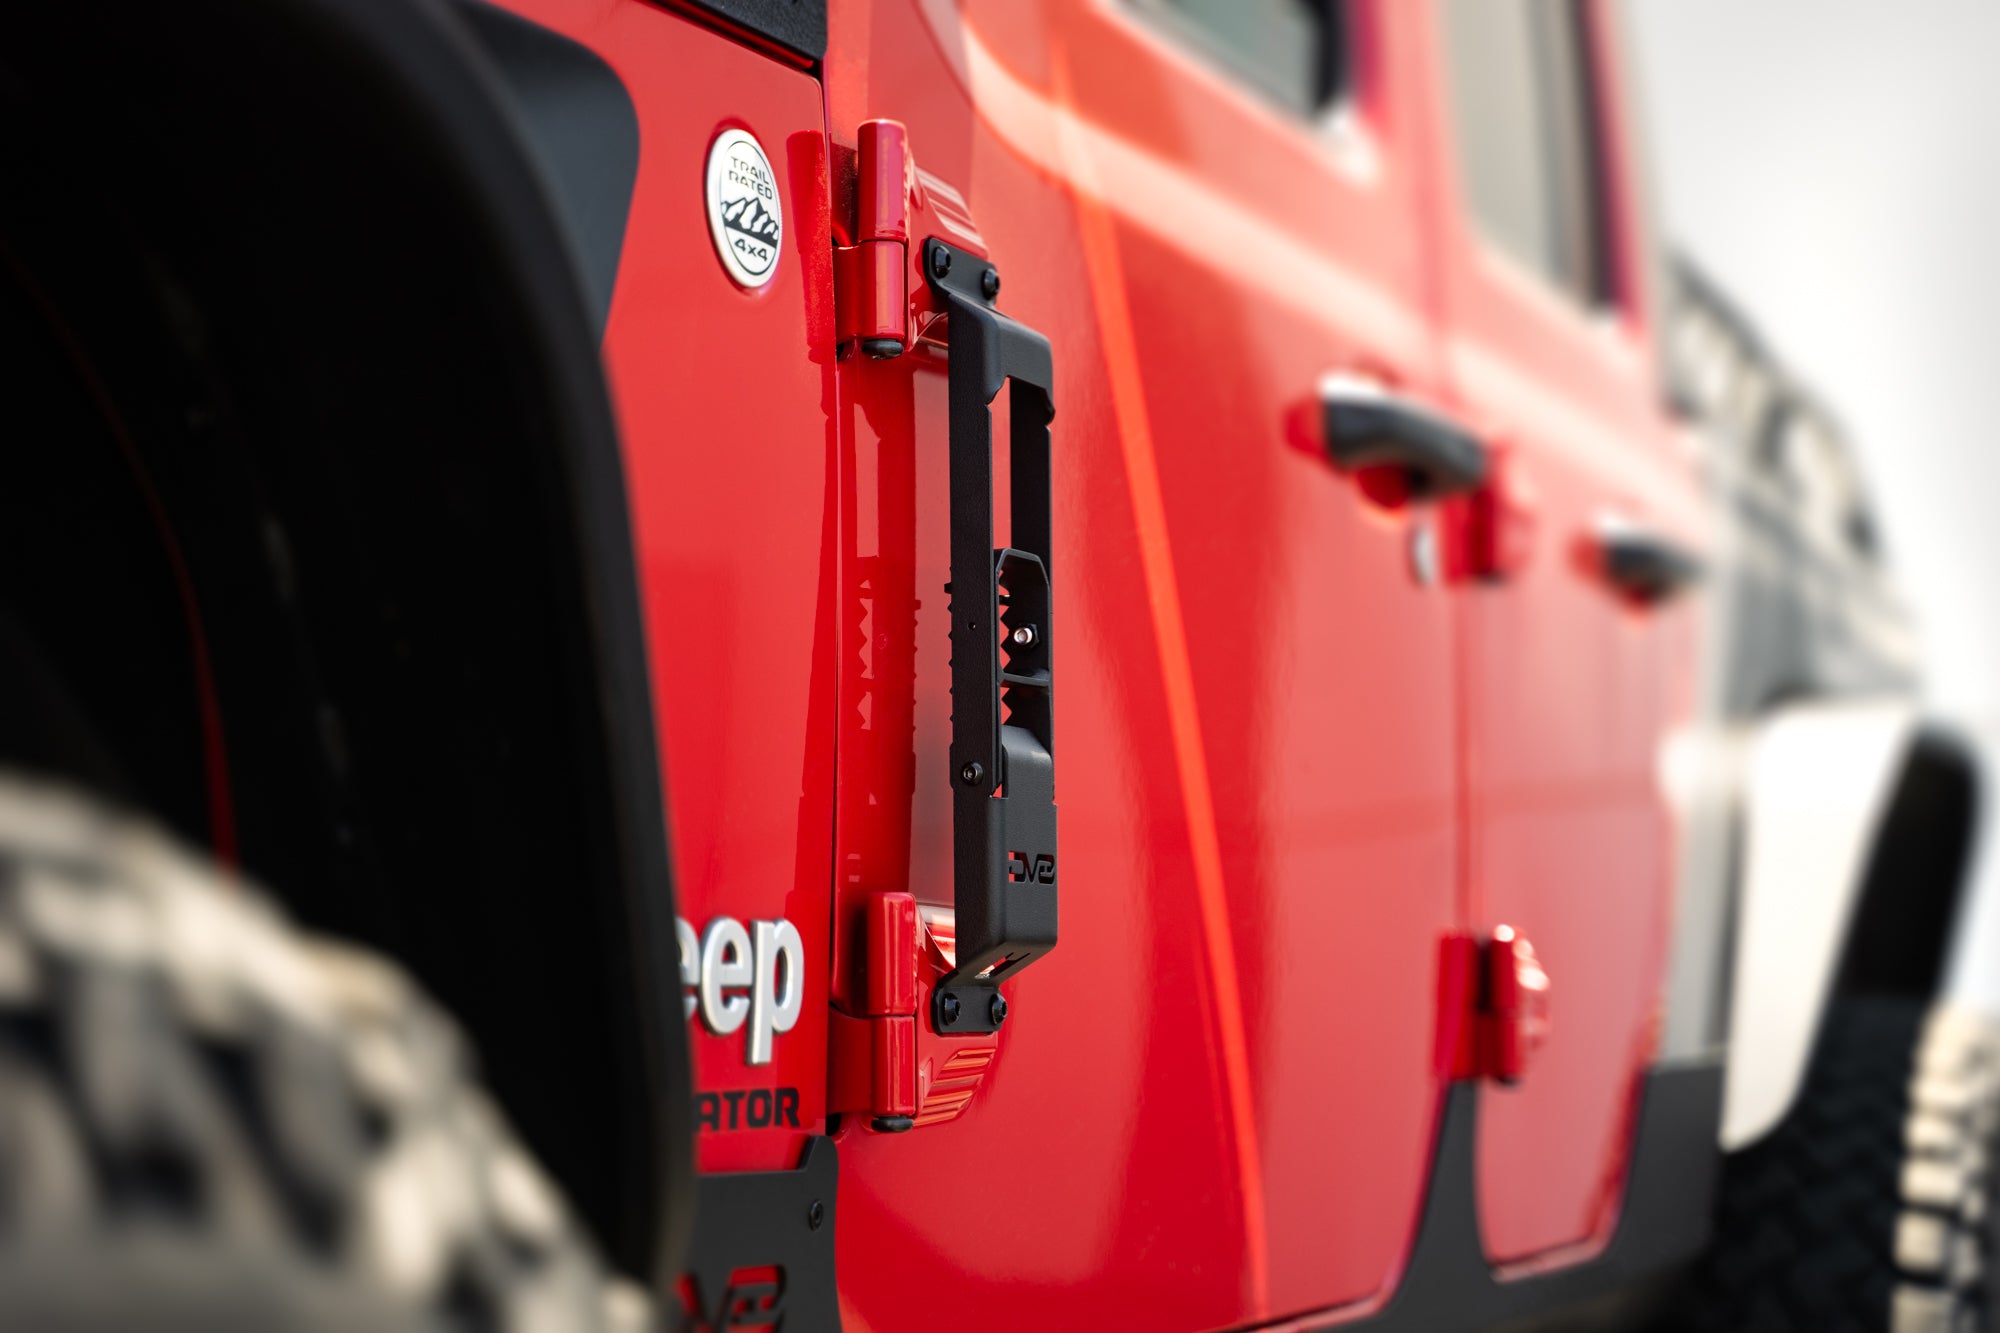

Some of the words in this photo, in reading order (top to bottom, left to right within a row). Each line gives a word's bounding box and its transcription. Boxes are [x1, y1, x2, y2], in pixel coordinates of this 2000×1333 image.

[728, 170, 773, 201] RATED
[730, 156, 770, 186] TRAIL
[734, 237, 769, 262] 4x4
